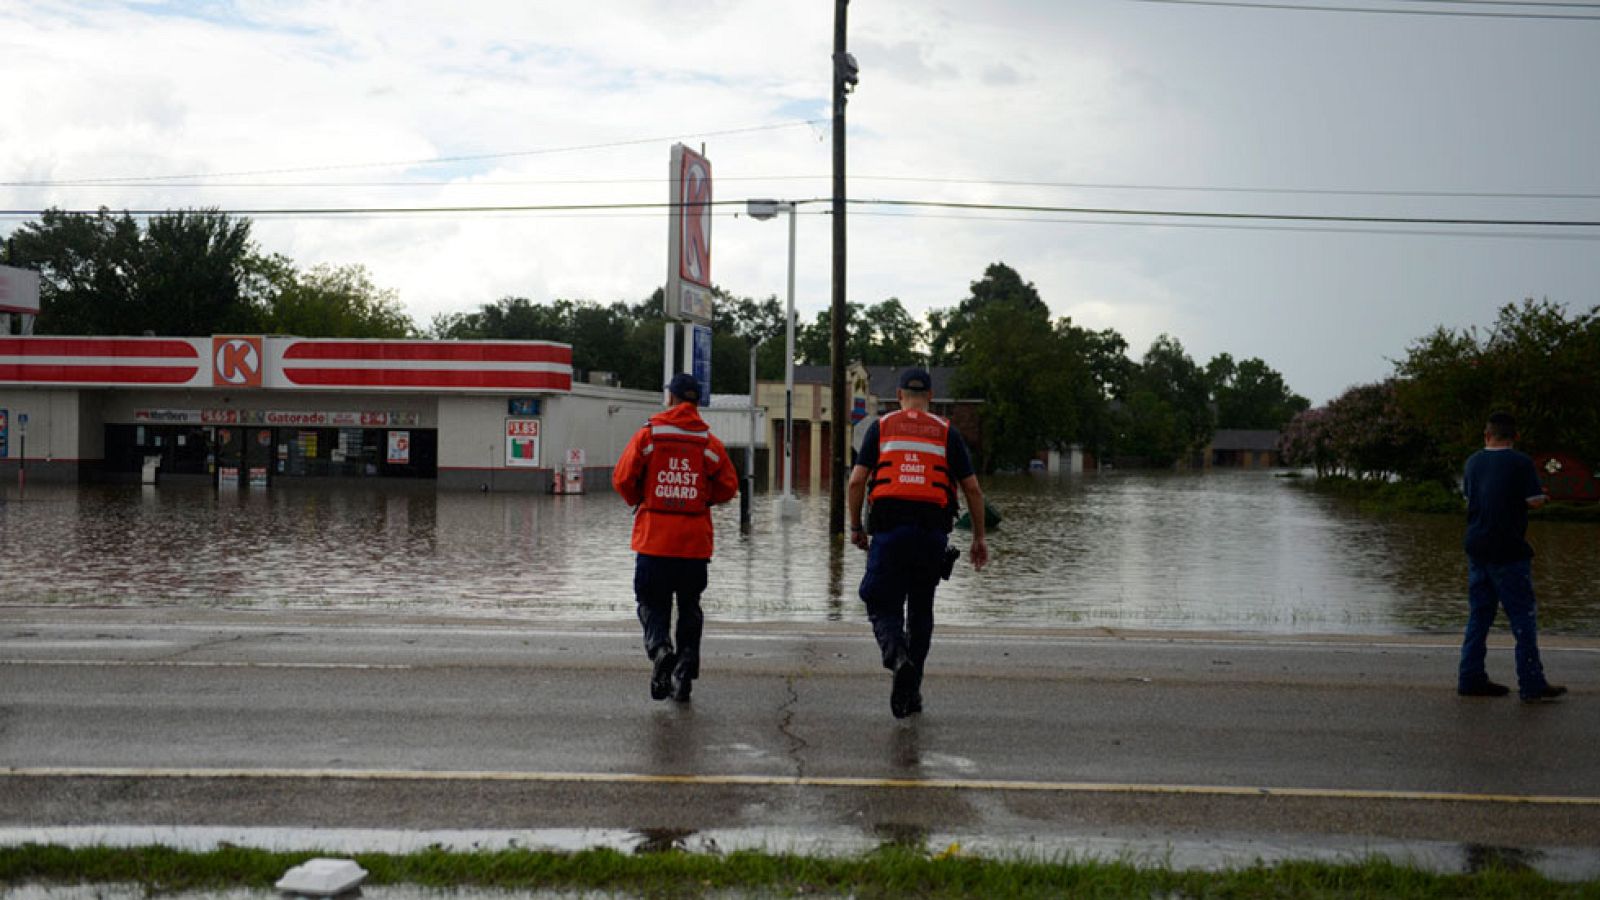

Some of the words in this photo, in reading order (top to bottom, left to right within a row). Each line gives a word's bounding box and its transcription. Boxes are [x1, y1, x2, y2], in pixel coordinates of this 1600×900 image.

[685, 164, 709, 280] K
[221, 341, 258, 384] K
[267, 411, 326, 424] Gatorade
[668, 457, 692, 471] U.S.
[900, 463, 925, 473] COAST
[657, 471, 699, 485] COAST
[899, 474, 925, 485] GUARD
[655, 485, 698, 499] GUARD
